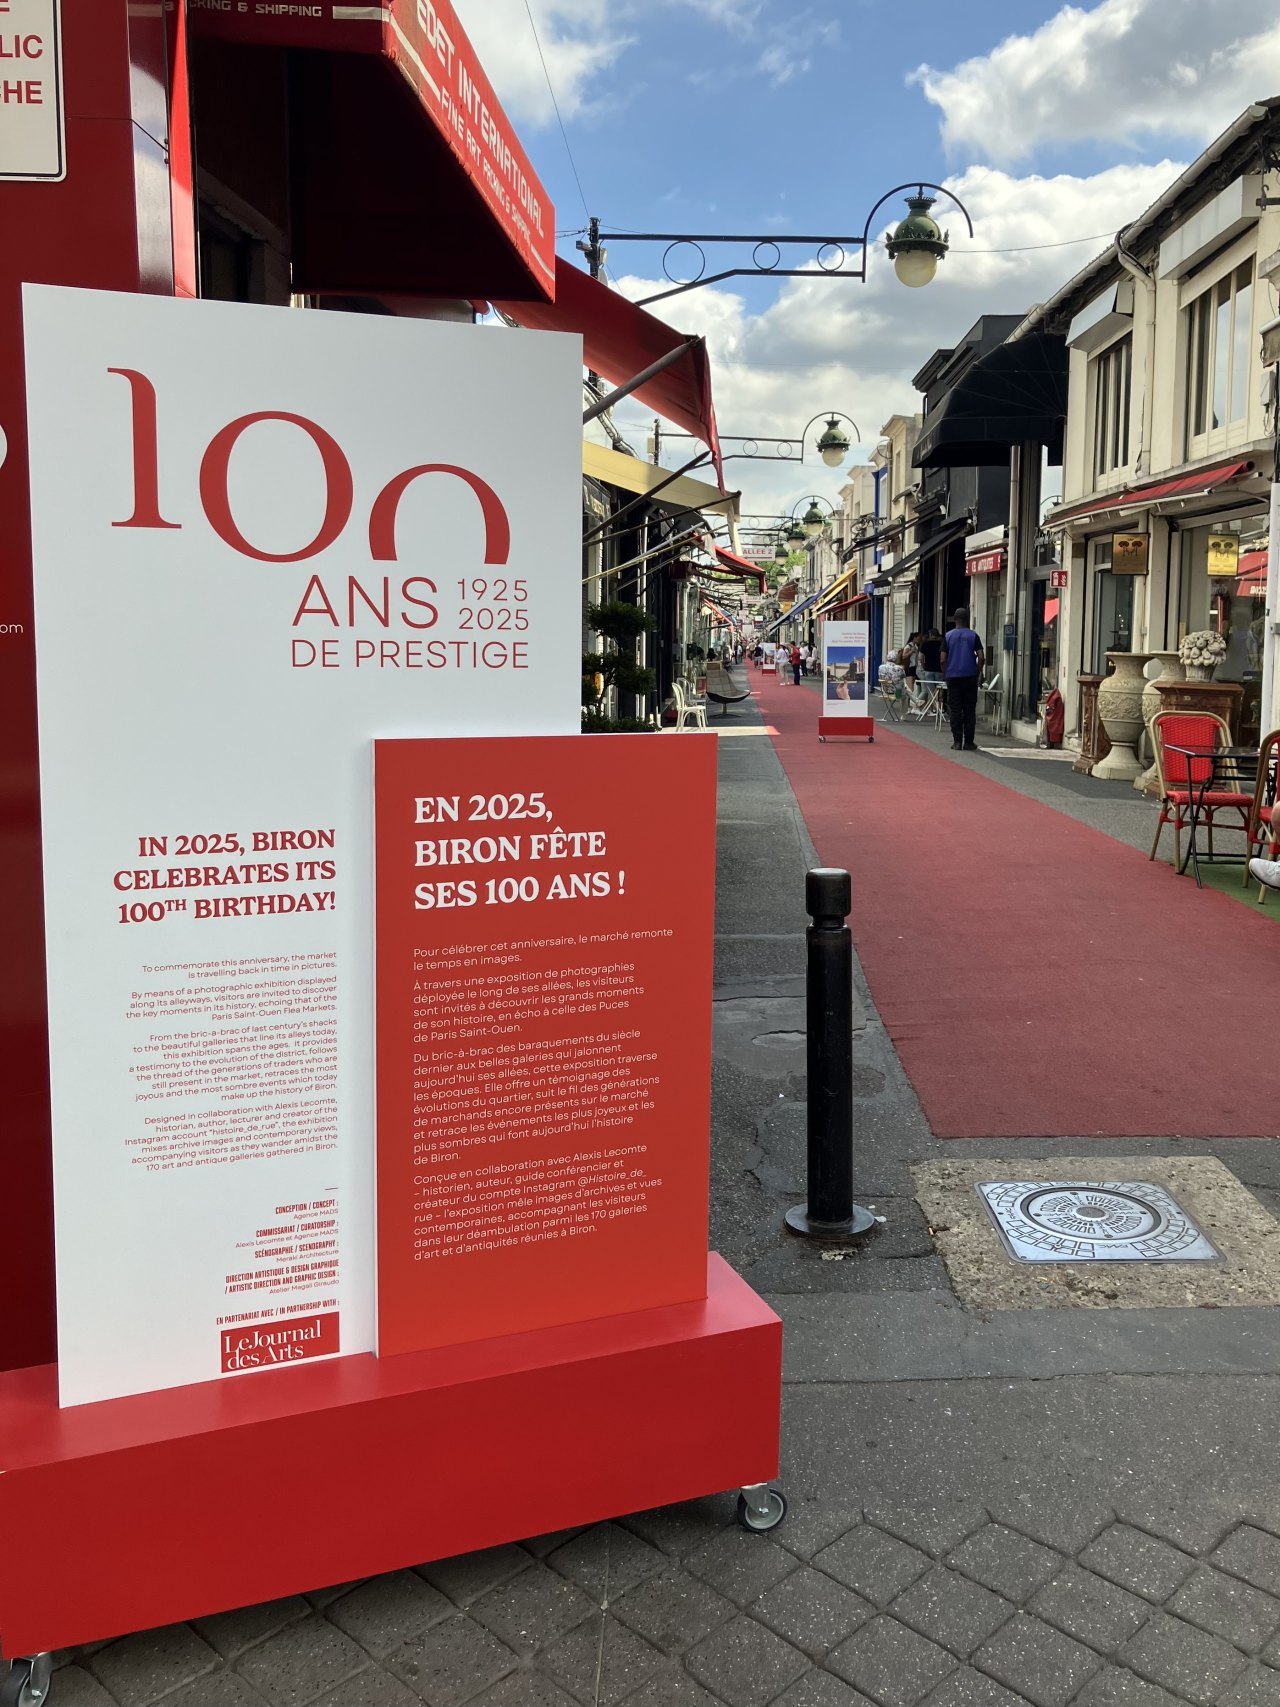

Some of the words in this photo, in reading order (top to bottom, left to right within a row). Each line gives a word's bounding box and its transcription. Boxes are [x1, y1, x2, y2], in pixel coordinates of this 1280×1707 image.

[238, 2, 248, 12] &
[256, 4, 322, 17] SHIPPING
[0, 80, 43, 104] HE
[442, 86, 464, 140] FINE
[466, 128, 481, 167] ART
[459, 59, 544, 238] INTERNATIONAL
[292, 574, 438, 629] ANS
[457, 578, 528, 602] 1925
[459, 608, 529, 631] 2025
[292, 640, 340, 668] DE
[356, 640, 529, 669] PRESTIGE
[414, 796, 458, 823] EN
[469, 792, 552, 822] 2025,
[139, 836, 167, 857] IN
[175, 832, 244, 856] 2025,
[253, 828, 334, 851] BIRON
[415, 835, 520, 866] BIRON
[531, 827, 606, 859] FÊTE
[113, 862, 288, 891] CELEBRATES
[296, 860, 336, 881] ITS
[414, 880, 476, 909] SES
[486, 876, 539, 904] 100
[548, 871, 610, 899] ANS
[618, 870, 624, 894] !
[195, 891, 335, 918] BIRTHDAY!
[413, 948, 438, 957] Pour
[441, 944, 487, 955] célébrer
[490, 942, 507, 951] cet
[510, 936, 576, 949] anniversaire,
[578, 934, 587, 943] le
[590, 930, 628, 942] marché
[631, 928, 673, 938] remonte
[153, 961, 220, 972] commemorate
[239, 956, 289, 968] anniversary,
[307, 951, 336, 960] market
[196, 969, 236, 978] travelling
[238, 966, 259, 975] back
[270, 961, 290, 972] time
[301, 961, 336, 971] pictures.
[413, 961, 423, 970] le
[426, 959, 461, 969] temps
[463, 958, 477, 966] en
[480, 954, 521, 965] images.
[131, 991, 142, 1000] By
[175, 987, 185, 995] of
[194, 982, 253, 995] photographic
[254, 980, 295, 989] exhibition
[297, 975, 336, 988] displayed
[413, 980, 421, 990] À
[423, 979, 461, 989] travers
[464, 977, 484, 986] une
[486, 971, 542, 984] exposition
[544, 969, 558, 978] de
[560, 962, 634, 978] photographies
[211, 1012, 232, 1020] Paris
[233, 1007, 281, 1019] Saint-Ouen
[283, 1004, 300, 1014] Flea
[302, 1004, 336, 1012] Markets.
[190, 1028, 240, 1038] bric-a-brac
[241, 1025, 250, 1033] of
[268, 1020, 307, 1032] century's
[308, 1018, 337, 1027] shacks
[413, 1053, 428, 1062] Du
[431, 1047, 493, 1060] bric-à-brac
[496, 1044, 515, 1053] des
[518, 1035, 594, 1050] baraquements
[596, 1032, 609, 1041] du
[611, 1029, 640, 1040] siècle
[146, 1163, 160, 1171] 170
[161, 1160, 174, 1169] art
[176, 1156, 193, 1167] and
[195, 1156, 228, 1165] antique
[229, 1148, 264, 1163] galleries
[265, 1145, 304, 1158] gathered
[413, 1172, 457, 1184] Conçue
[459, 1170, 472, 1178] en
[475, 1159, 544, 1176] collaboration
[547, 1155, 571, 1165] avec
[572, 1150, 601, 1162] Alexis
[604, 1144, 647, 1157] Lecomte
[275, 1203, 307, 1214] CONCEPTION
[312, 1198, 335, 1209] CONCEPT
[293, 1211, 318, 1220] Agence
[319, 1208, 338, 1216] MADS
[255, 1224, 295, 1237] COMMISSARIAT
[300, 1219, 335, 1231] CURATORSHIP
[414, 1249, 439, 1260] d'art
[442, 1247, 453, 1256] et
[455, 1236, 518, 1253] d'antiquités
[520, 1230, 558, 1243] réunies
[560, 1227, 566, 1236] à
[569, 1224, 597, 1235] Biron.
[225, 1272, 253, 1283] DIRECTION
[254, 1267, 284, 1279] ARTISTIQUE
[290, 1263, 309, 1273] DESIGN
[310, 1258, 339, 1270] GRAPHIQUE
[228, 1282, 252, 1293] ARTISTIC
[253, 1278, 281, 1289] DIRECTION
[282, 1276, 293, 1284] AND
[294, 1272, 316, 1282] GRAPHIC
[317, 1269, 336, 1279] DESIGN
[216, 1316, 223, 1325] EN
[224, 1310, 259, 1323] PARTENARIAT
[260, 1308, 273, 1317] AVEC
[286, 1300, 321, 1313] PARTNERSHIP
[322, 1298, 336, 1307] WITH
[227, 1348, 260, 1370] des
[262, 1345, 304, 1364] Arts
